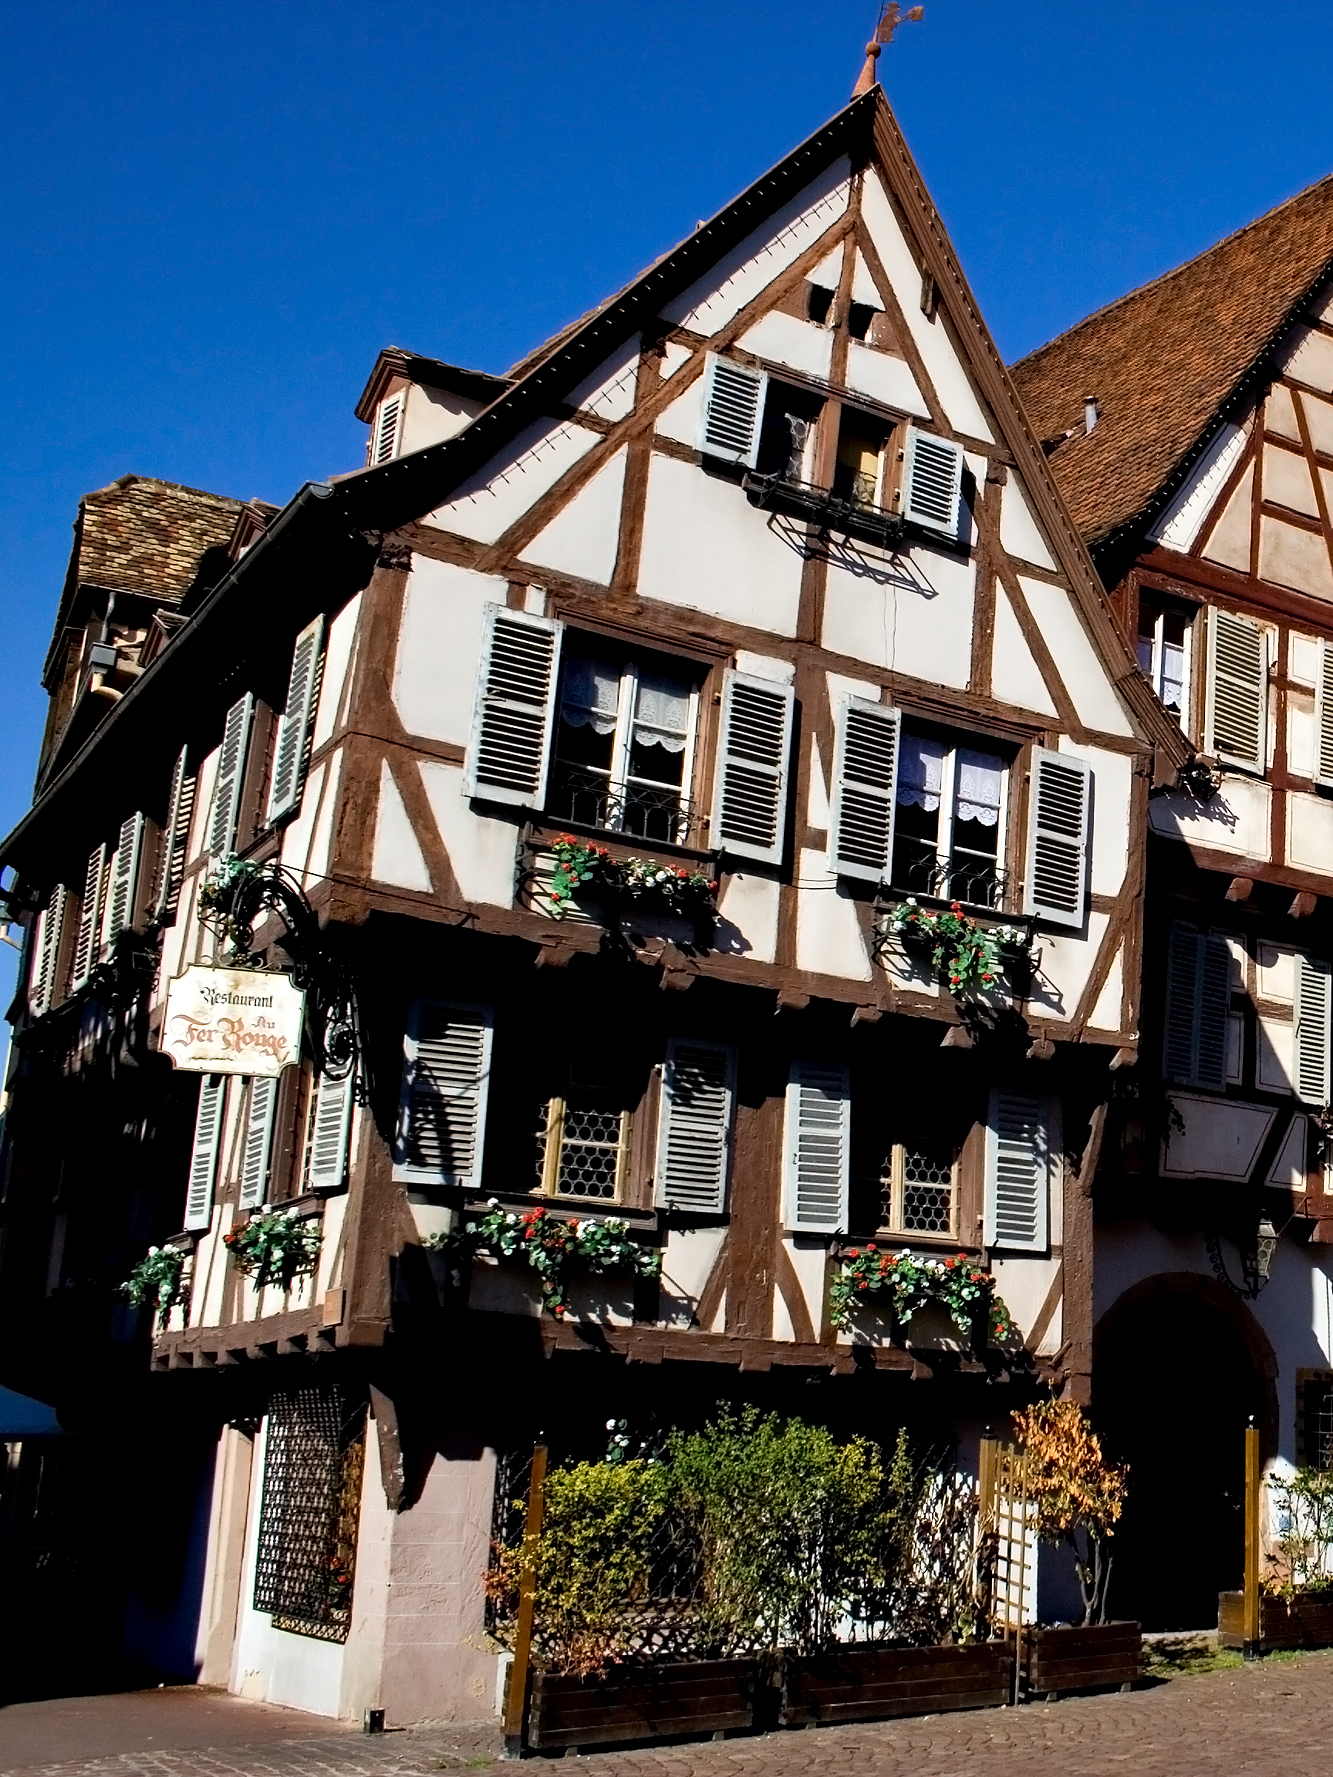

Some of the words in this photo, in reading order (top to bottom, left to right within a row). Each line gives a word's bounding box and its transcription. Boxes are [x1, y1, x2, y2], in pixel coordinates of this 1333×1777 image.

[200, 987, 274, 1008] Restaurant
[171, 1013, 217, 1050] Fer
[217, 1016, 288, 1057] Rouge
